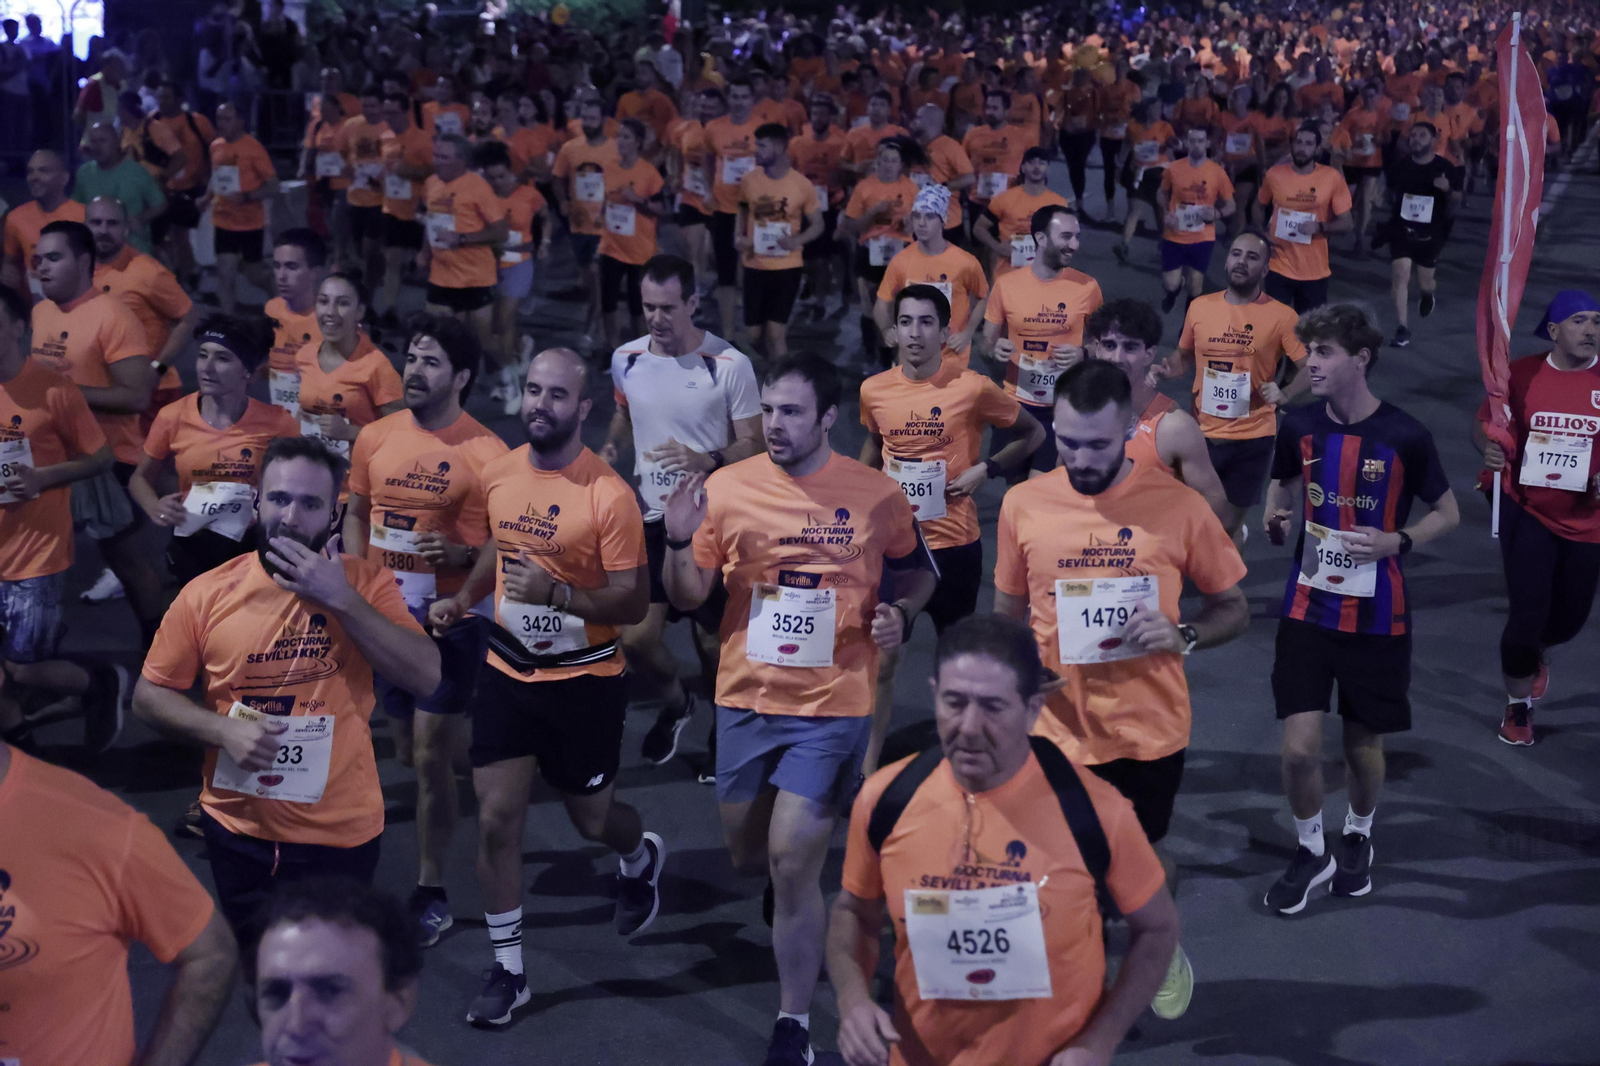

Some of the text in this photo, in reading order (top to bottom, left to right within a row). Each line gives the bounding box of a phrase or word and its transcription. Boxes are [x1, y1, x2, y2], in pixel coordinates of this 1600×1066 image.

[1030, 373, 1055, 385] 2750
[1213, 386, 1237, 400] 3618
[905, 421, 945, 429] NOCTURNA
[1534, 415, 1597, 432] BILIO'S
[211, 462, 255, 470] NOCTURNA
[1539, 451, 1578, 468] 17775
[384, 477, 424, 490] SEVILLA
[406, 472, 450, 486] NOCTURNA
[898, 481, 932, 497] 6361
[1328, 492, 1378, 511] Spotify
[498, 520, 534, 535] SEVILLA
[518, 515, 558, 531] NOCTURNA
[801, 527, 854, 535] NOCTURNA
[779, 535, 825, 546] SEVILLA
[1082, 547, 1136, 556] NOCTURNA
[1318, 548, 1358, 569] 1565
[382, 551, 415, 571] 1380
[1057, 558, 1106, 569] SEVILLA
[522, 615, 562, 633] 3420
[772, 612, 815, 634] 3525
[274, 636, 333, 649] NOCTURNA
[246, 648, 299, 664] SEVILLA
[277, 745, 303, 764] 33
[954, 865, 1031, 882] NOCTURNA
[947, 927, 1011, 955] 4526
